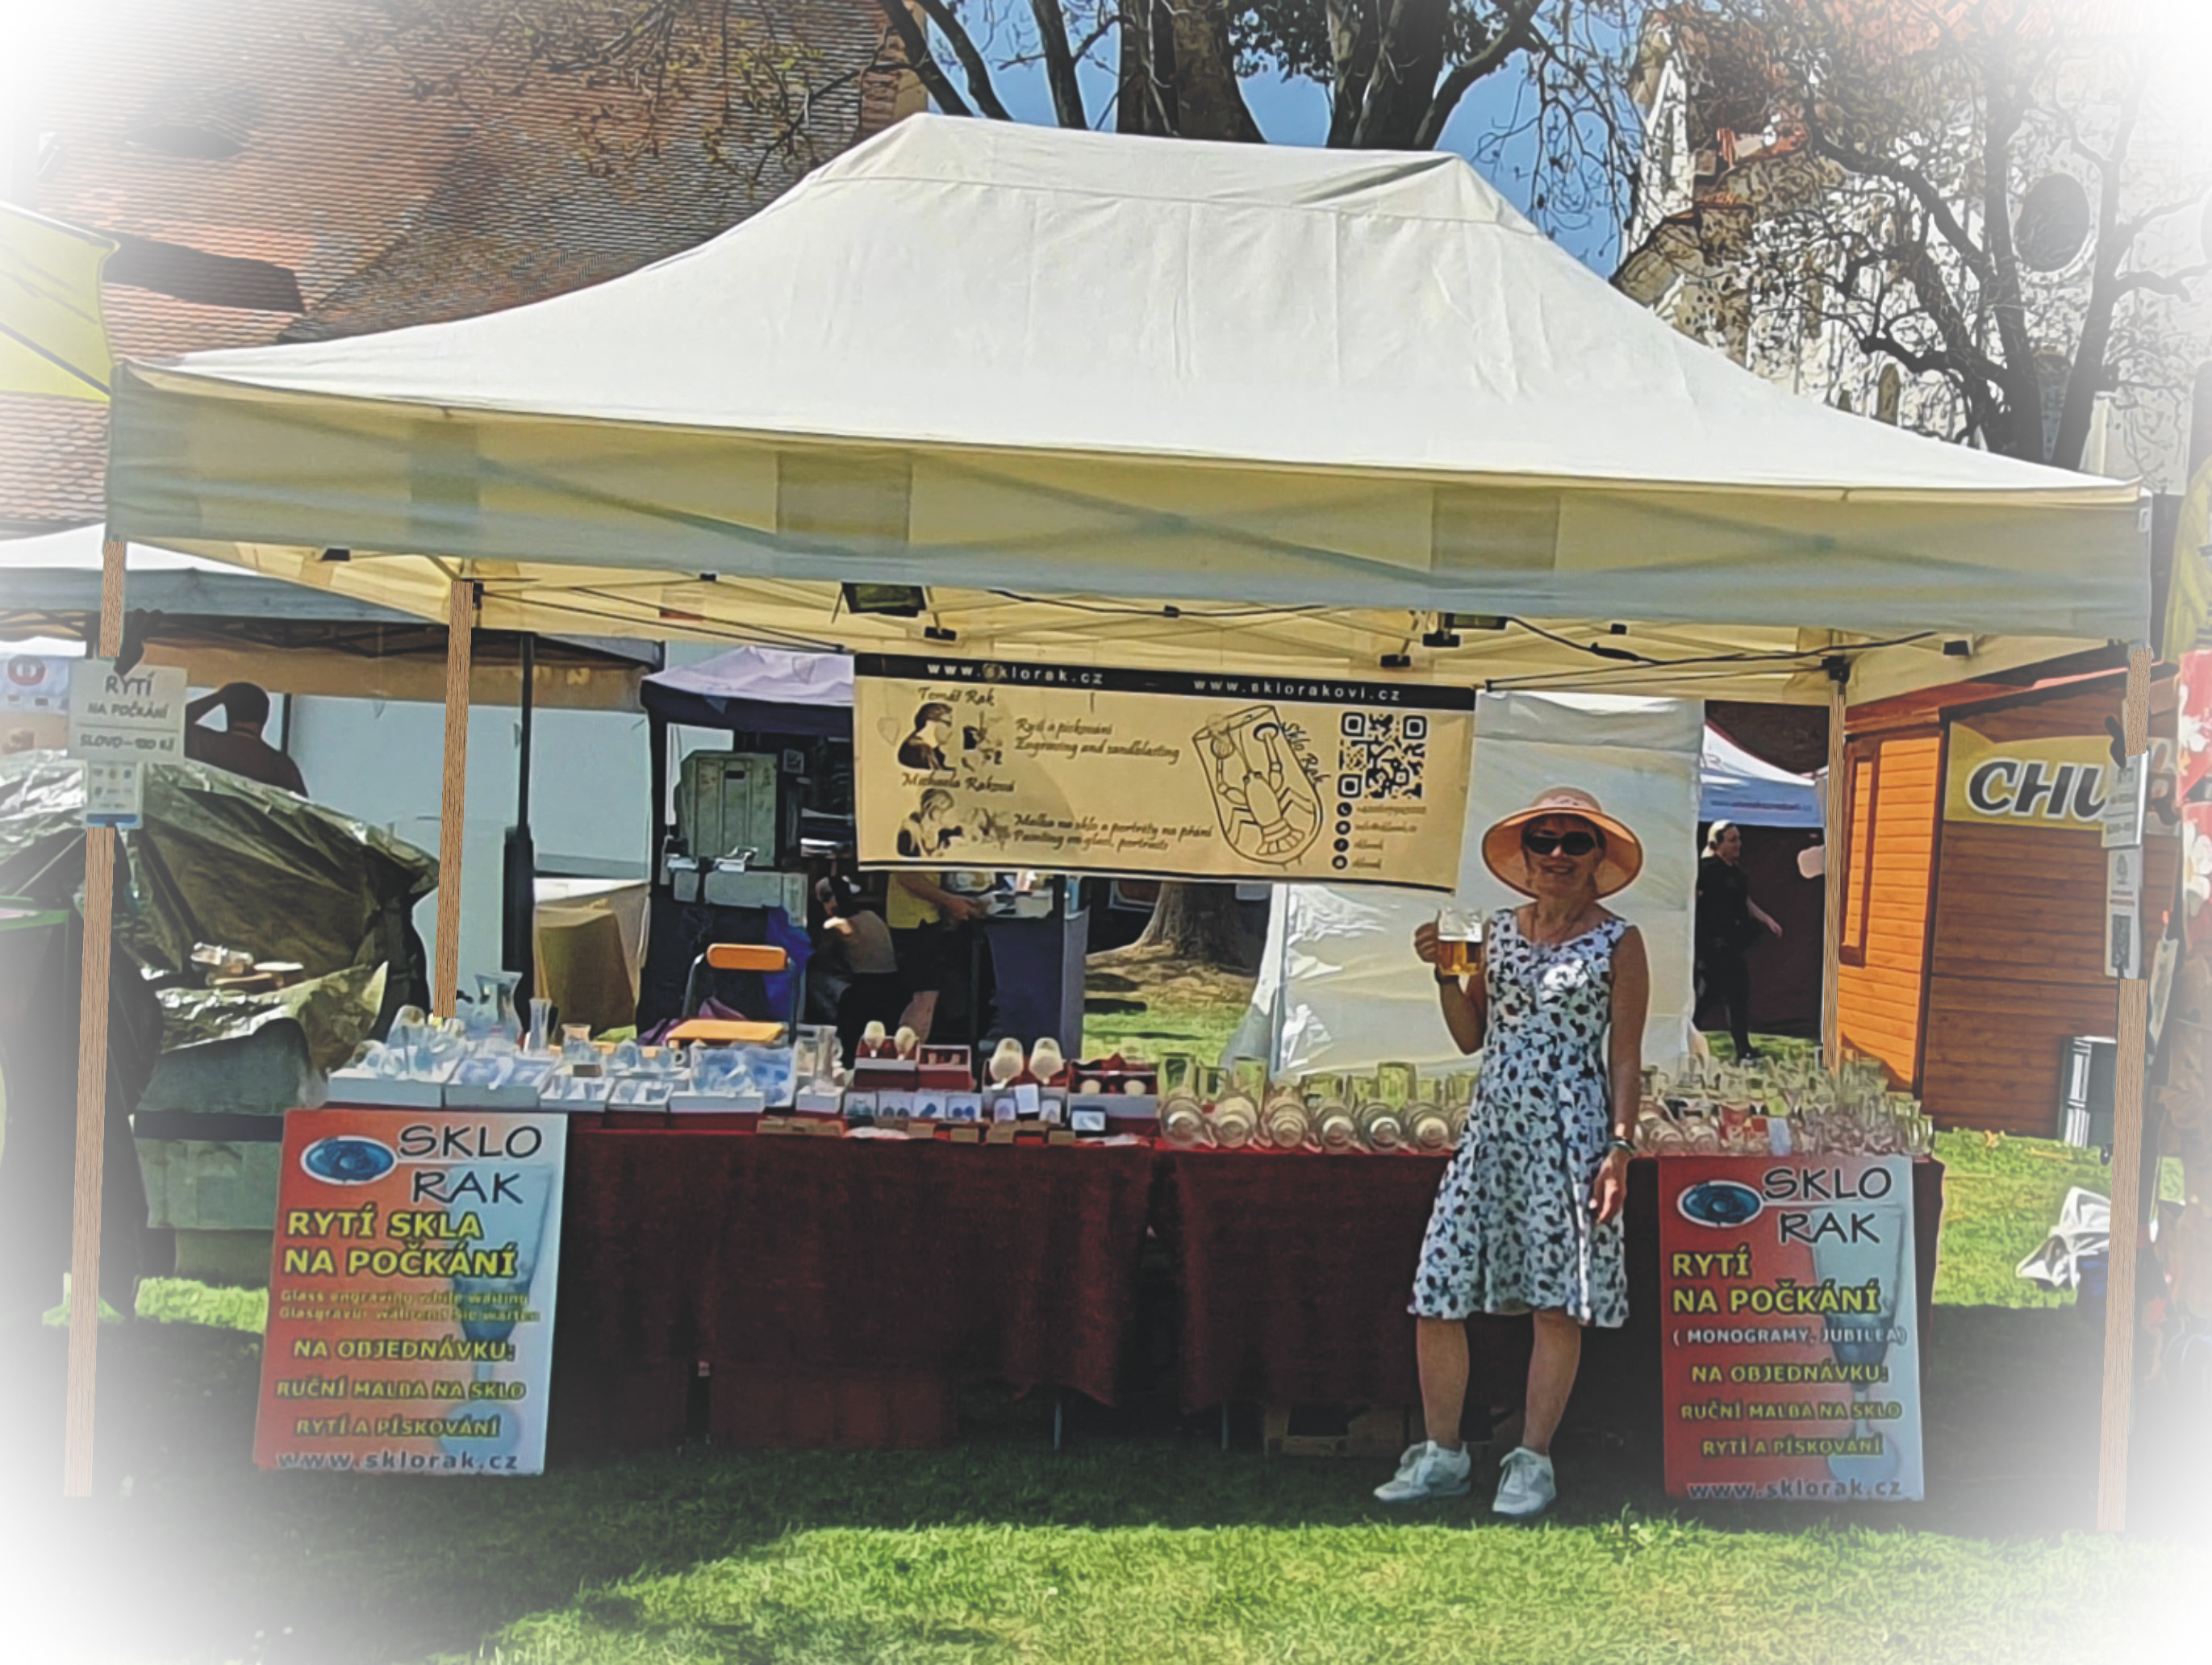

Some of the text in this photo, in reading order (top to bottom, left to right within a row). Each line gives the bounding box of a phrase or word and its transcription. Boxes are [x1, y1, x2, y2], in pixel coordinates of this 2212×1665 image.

[105, 672, 156, 696] RYTÍ
[1193, 680, 1400, 701] www.sklorakovi.cz
[399, 1125, 542, 1158] SKLO
[412, 1171, 523, 1204] RAK
[1764, 1166, 1893, 1199] SKLO
[287, 1203, 482, 1237] RYTÍ SKLA
[1780, 1212, 1880, 1243] RAK
[283, 1241, 519, 1276] NA POČKÁNÍ
[1672, 1243, 1752, 1277] RYTÍ
[280, 1289, 324, 1302] Glass
[329, 1291, 413, 1305] engraving
[1672, 1279, 1882, 1315] NA POČKÁNÍ
[293, 1335, 515, 1361] NA OBJEDNÁVKU:
[1691, 1358, 1889, 1383] NA OBJEDNÁVKU:
[276, 1377, 528, 1400] RUČNÍ MALBA NA SKLO
[1680, 1400, 1903, 1421] RUČNÍ MALBA NA SKLO
[295, 1413, 501, 1438] RYTÍ A PÍSKOVÁNÍ
[1701, 1433, 1884, 1457] RYTÍ A PÍSKOVÁNÍ
[277, 1450, 519, 1471] www.sklorak.cz
[1687, 1479, 1902, 1500] www.sklorak.cz
